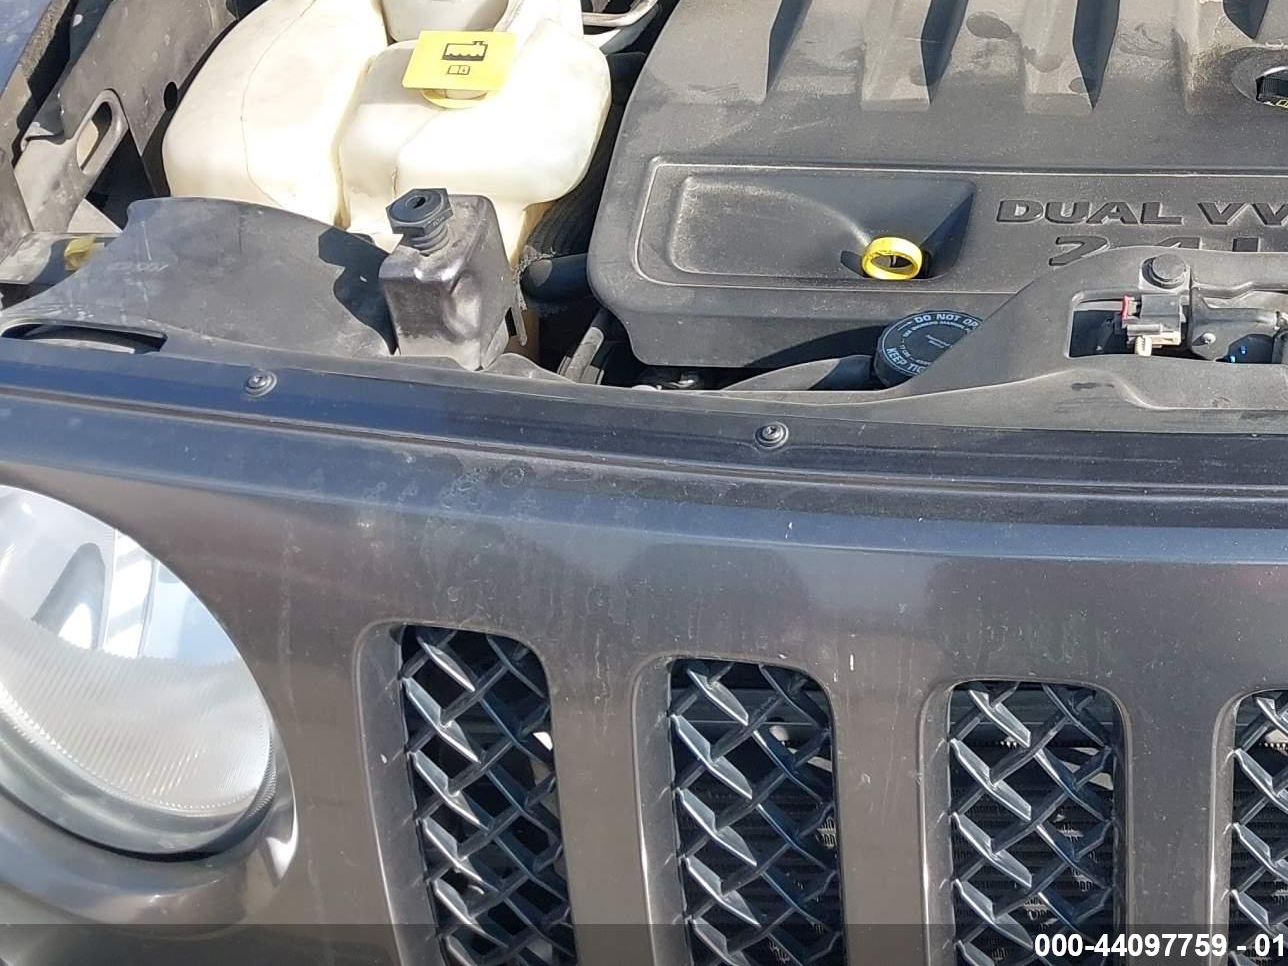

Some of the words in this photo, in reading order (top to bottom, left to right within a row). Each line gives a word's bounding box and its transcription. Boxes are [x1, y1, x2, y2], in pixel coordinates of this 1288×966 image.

[996, 199, 1185, 226] DUAL
[914, 314, 932, 324] DO
[936, 313, 961, 322] NOT
[962, 317, 980, 328] OP
[886, 346, 906, 366] KEEP
